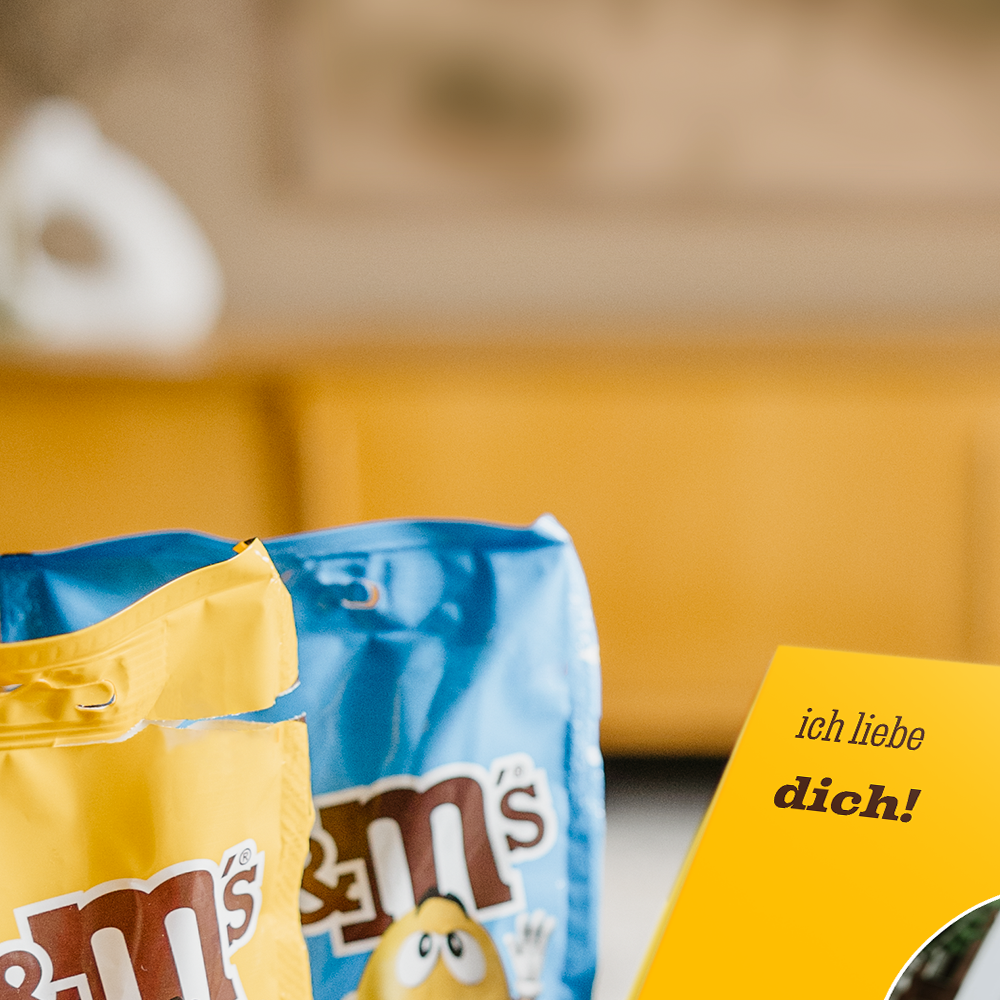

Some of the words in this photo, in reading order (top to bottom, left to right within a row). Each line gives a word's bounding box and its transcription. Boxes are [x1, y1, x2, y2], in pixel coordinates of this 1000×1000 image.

[795, 707, 845, 743] ich
[847, 711, 925, 751] liebe
[773, 775, 922, 823] dich!
